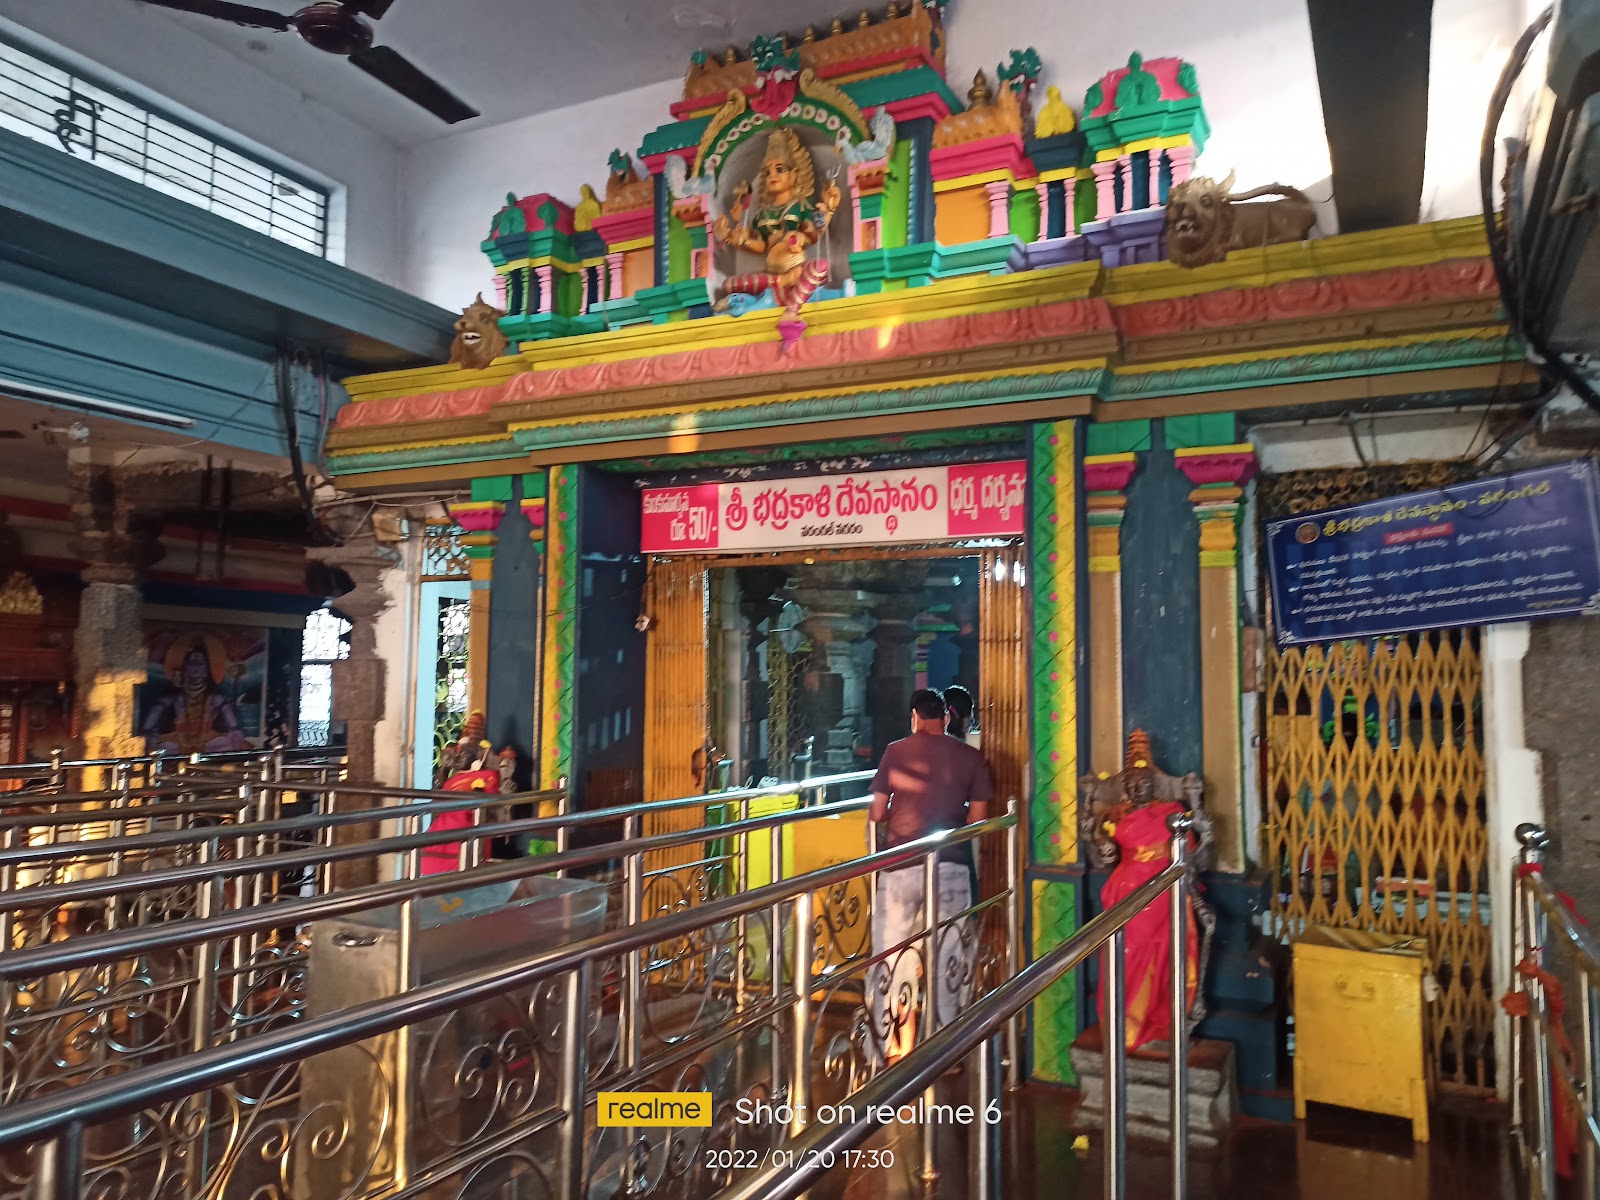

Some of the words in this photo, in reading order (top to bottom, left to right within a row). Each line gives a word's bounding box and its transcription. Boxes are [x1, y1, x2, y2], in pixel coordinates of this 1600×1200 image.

[725, 486, 748, 531] శ్రీ
[753, 484, 831, 531] భద్రకాళి
[836, 476, 939, 535] దేవస్థానం
[950, 476, 979, 520] ధర్మ
[689, 505, 718, 544] 50/-
